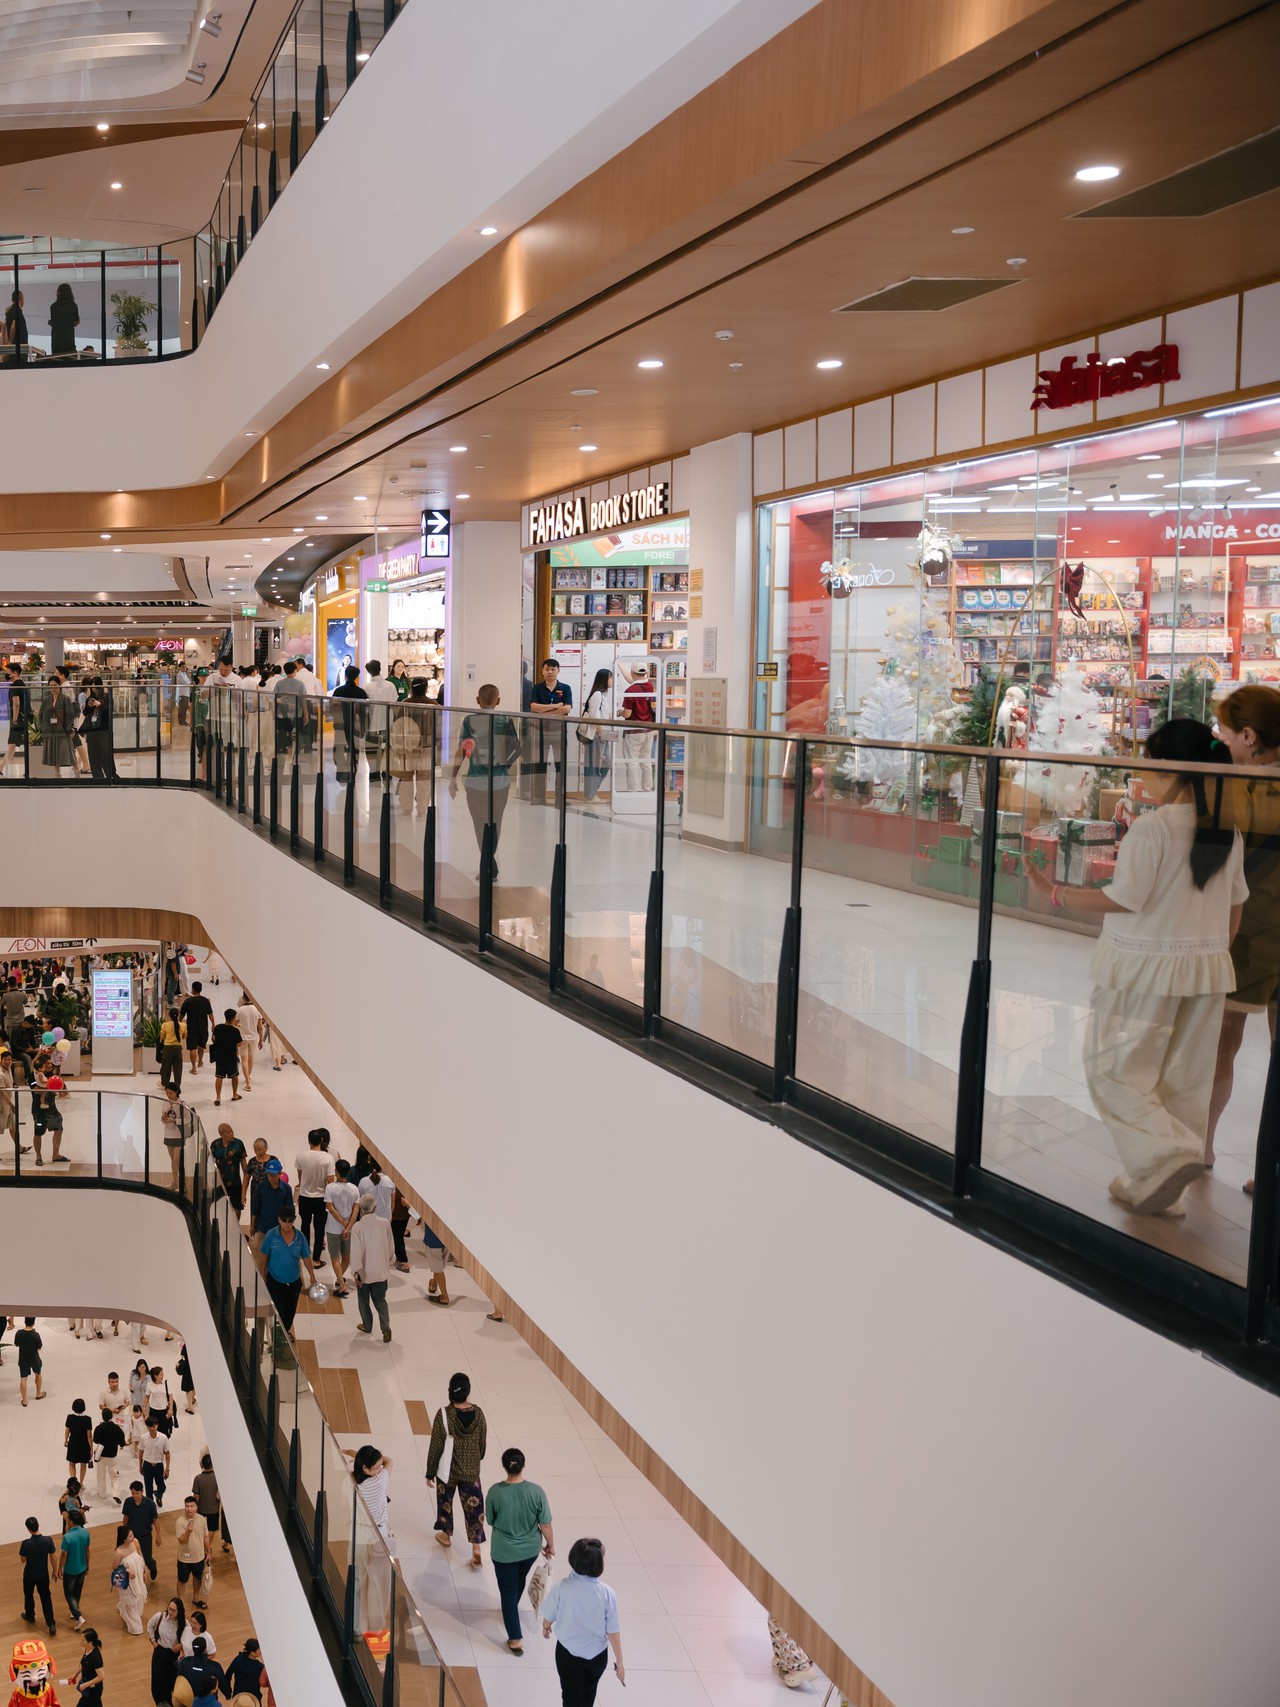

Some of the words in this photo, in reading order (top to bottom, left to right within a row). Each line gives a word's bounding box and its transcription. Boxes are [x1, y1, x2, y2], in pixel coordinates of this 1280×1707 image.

[530, 497, 586, 545] FAHASA
[632, 530, 670, 544] SÁCH
[1165, 524, 1239, 540] MANGA
[100, 642, 128, 650] WORLD
